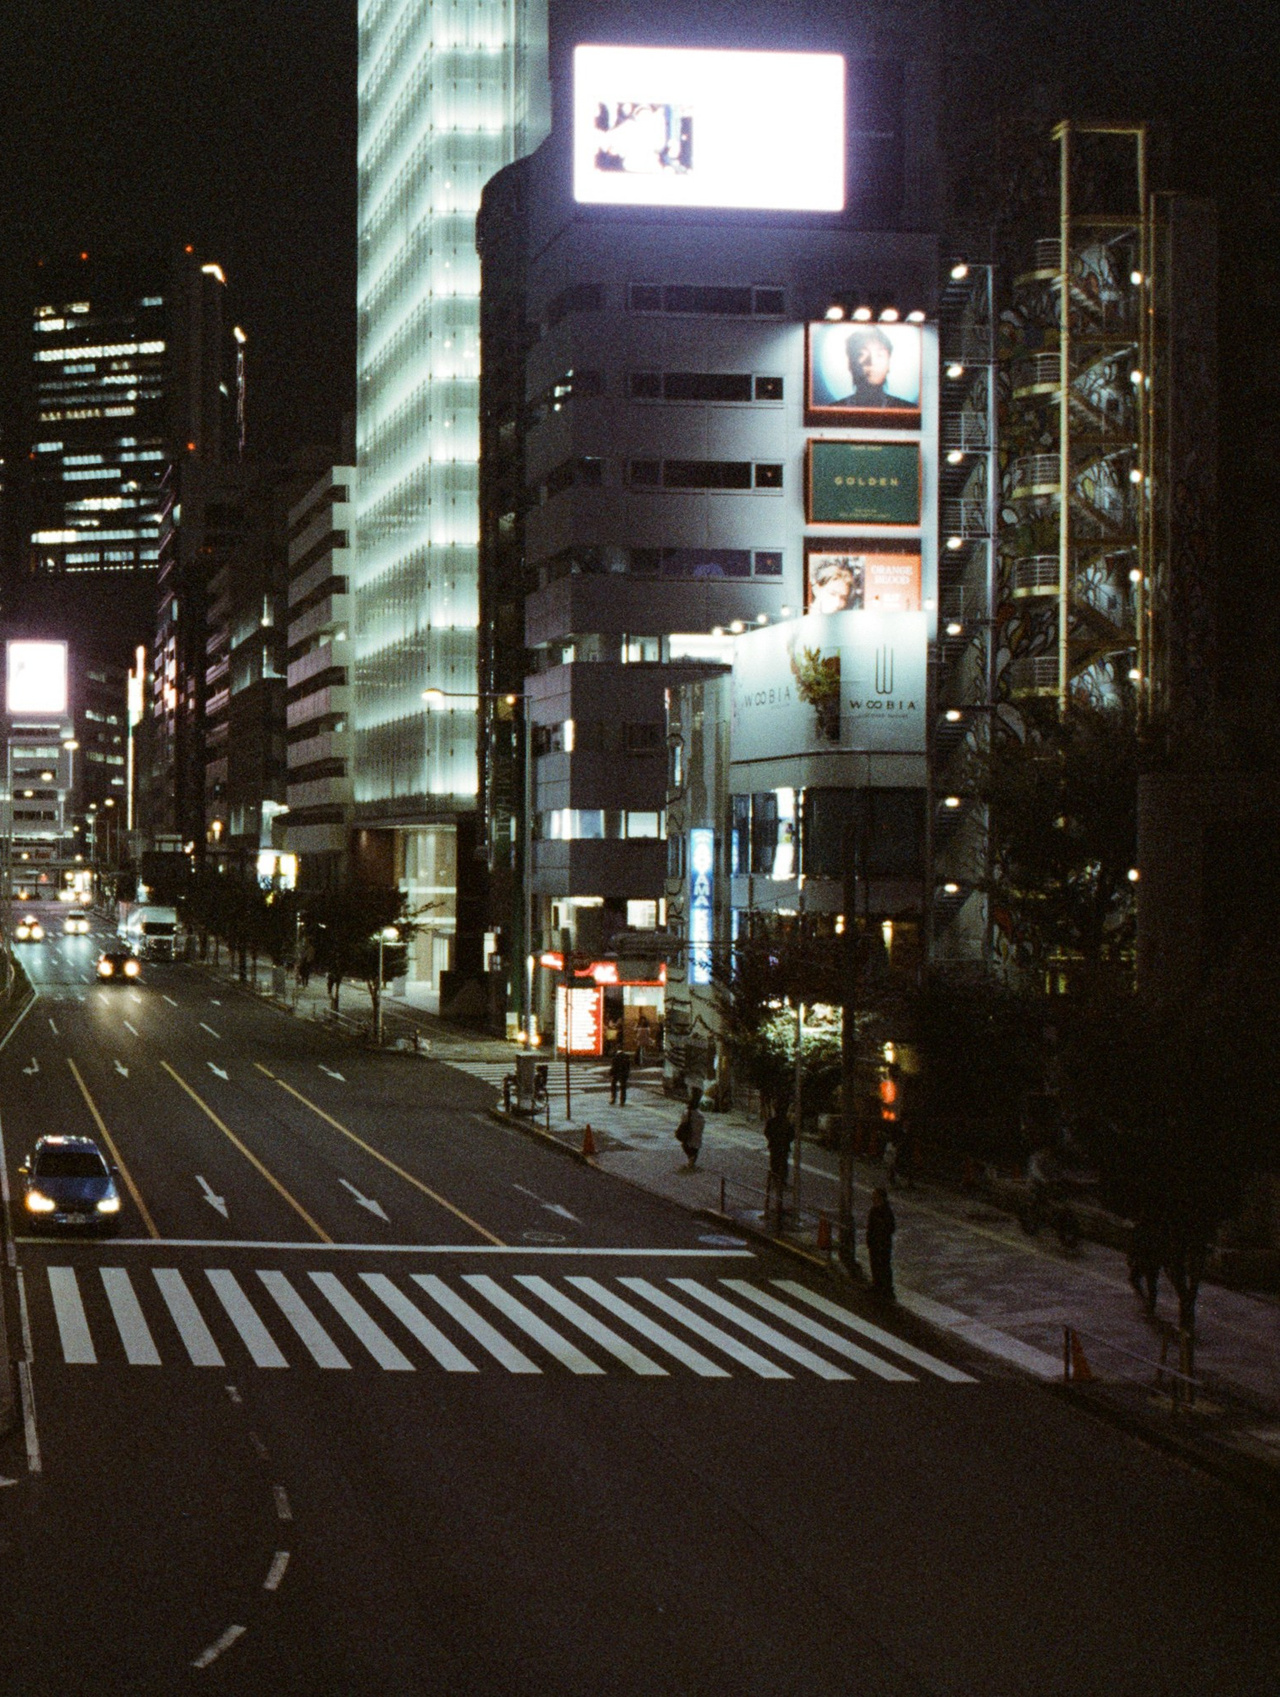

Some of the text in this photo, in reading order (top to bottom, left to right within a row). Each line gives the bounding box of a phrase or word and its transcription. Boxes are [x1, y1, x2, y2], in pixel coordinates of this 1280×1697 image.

[834, 475, 900, 487] GOLDEN
[870, 564, 913, 575] ORANGE
[874, 575, 910, 585] BLOOD
[744, 685, 791, 708] WOOBIA
[849, 700, 917, 711] WOOBIA
